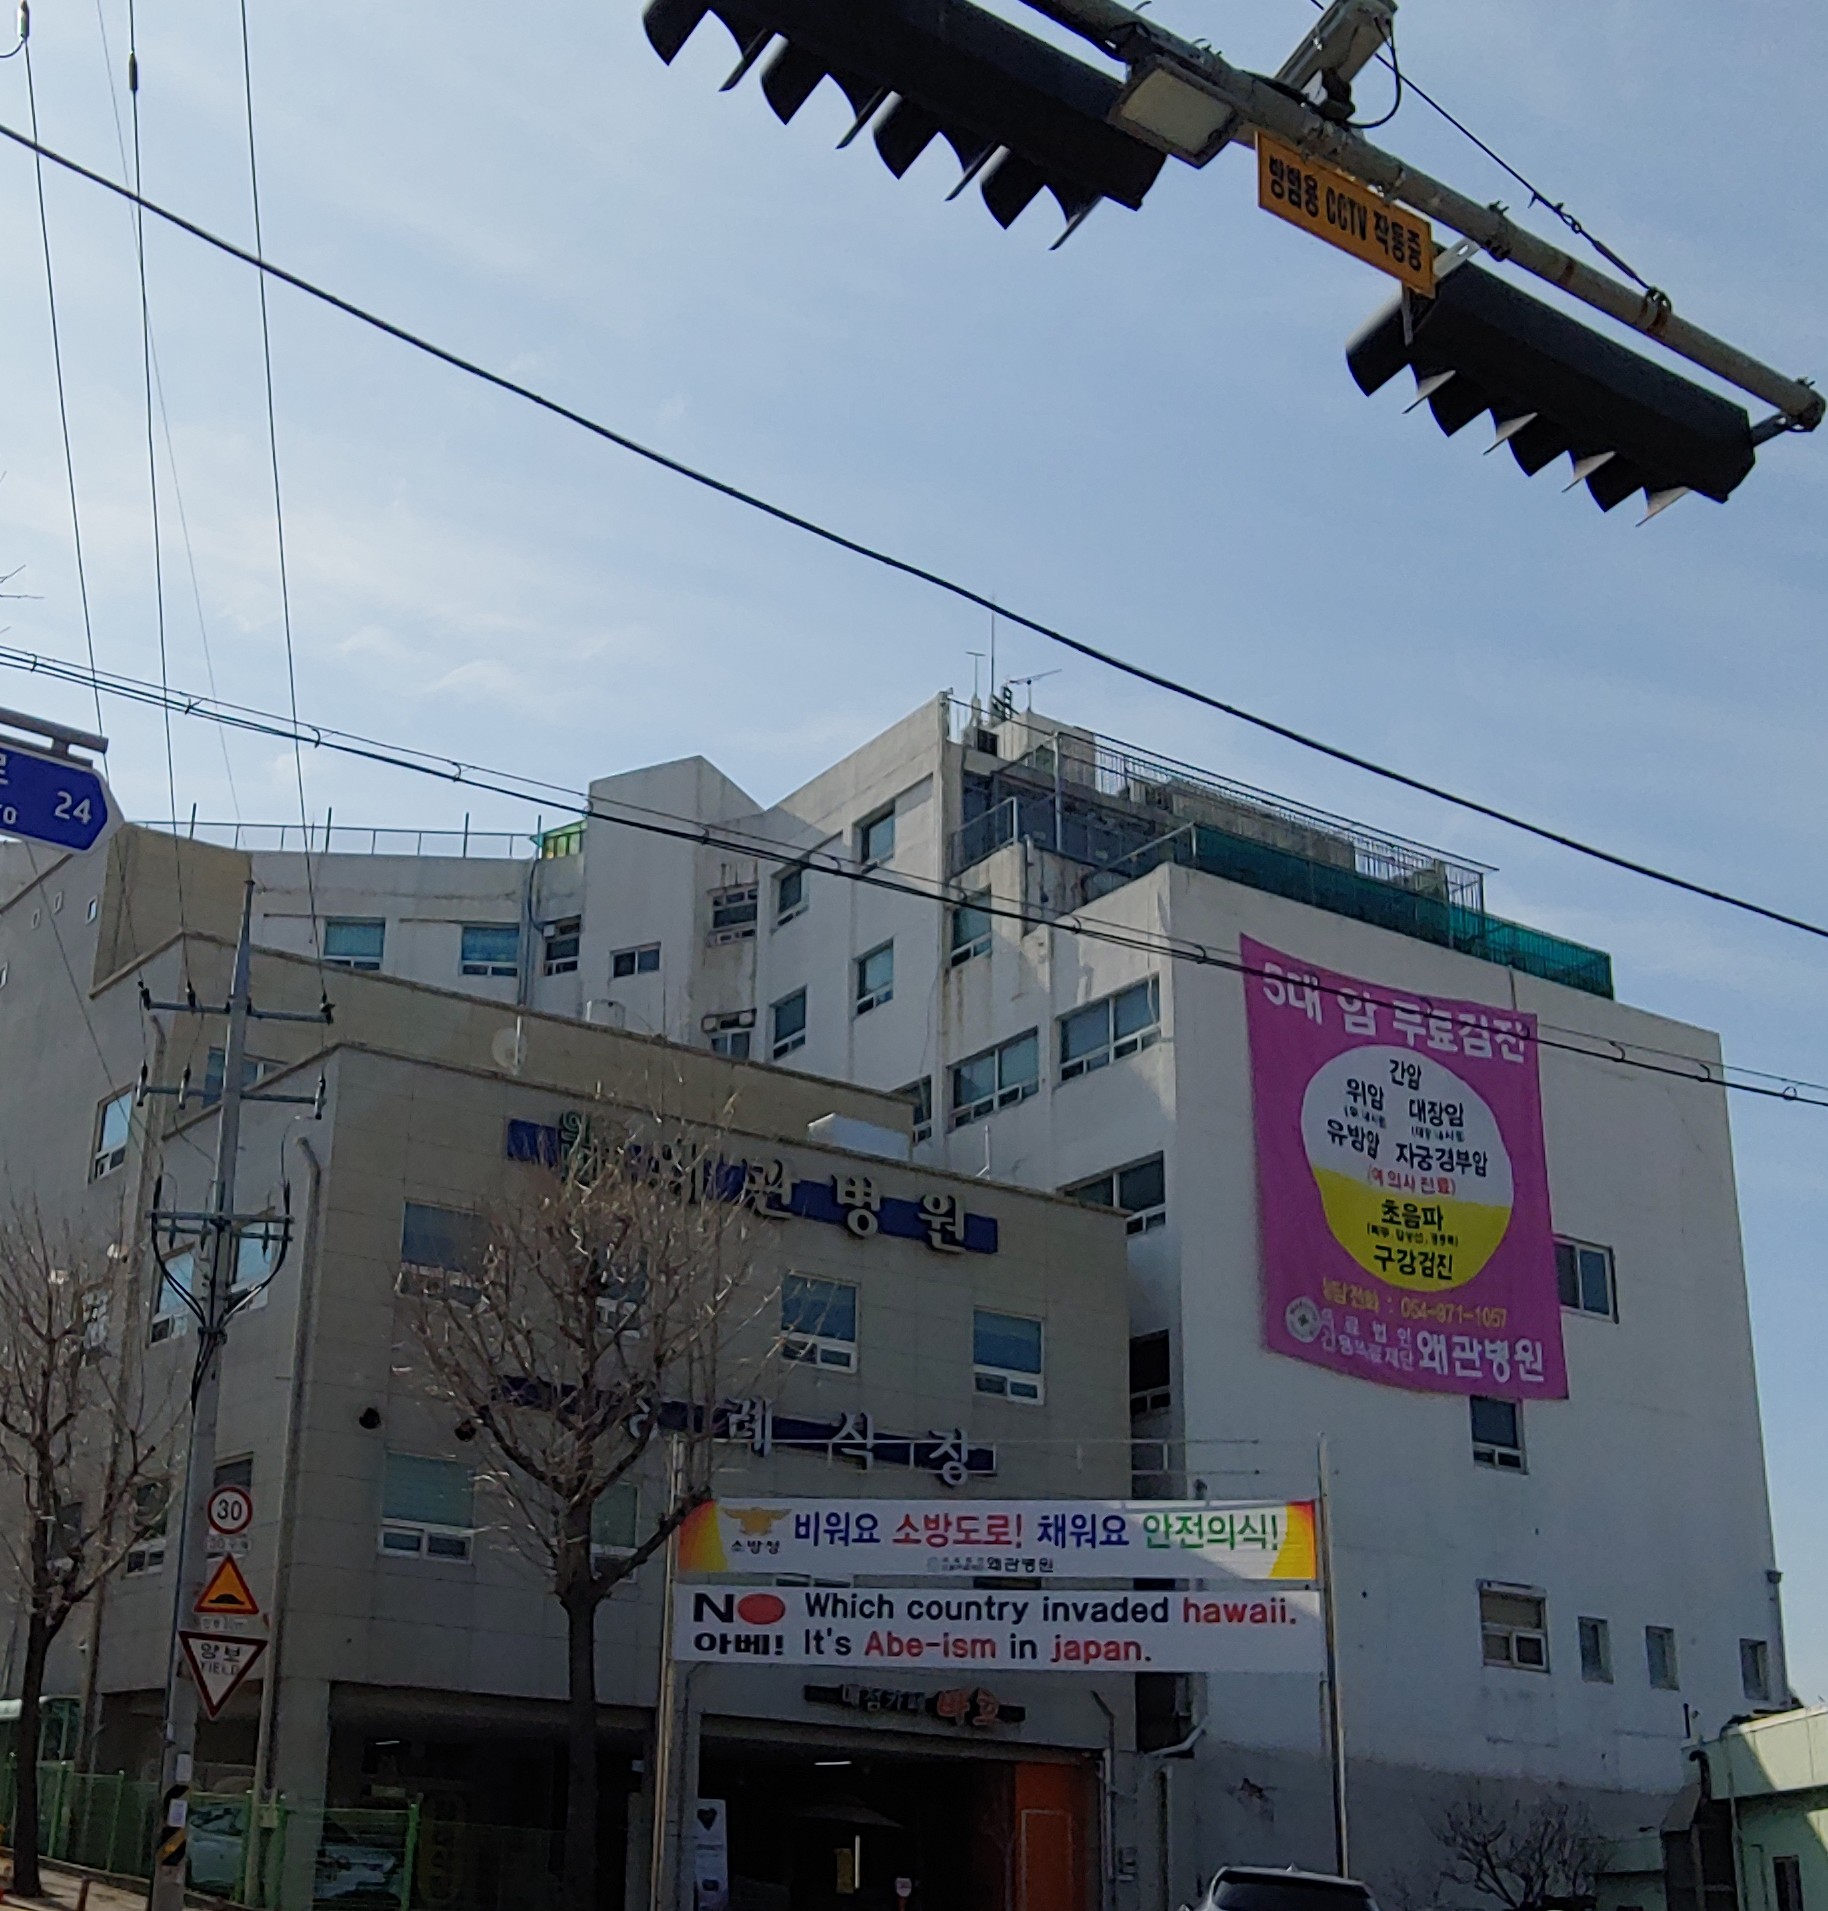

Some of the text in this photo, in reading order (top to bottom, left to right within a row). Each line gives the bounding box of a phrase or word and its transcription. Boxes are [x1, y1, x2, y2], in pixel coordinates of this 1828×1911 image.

[1268, 154, 1422, 272] 방범용 CCTV 작동중
[54, 790, 92, 824] 24
[1262, 961, 1527, 1061] 5대 암 무료검진
[1389, 1058, 1422, 1091] 간암
[1345, 1078, 1385, 1111] 위암
[1408, 1098, 1464, 1128] 대장암
[1327, 1118, 1380, 1160] 유방암
[1395, 1142, 1488, 1178] 자궁경부암
[1381, 1198, 1444, 1231] 초음파
[1373, 1244, 1453, 1280] 구강검진
[1416, 1329, 1545, 1383] 왜관병원
[627, 1397, 968, 1487] 례식장
[216, 1499, 243, 1521] 30
[731, 1539, 781, 1555] 소방청
[794, 1511, 1279, 1551] 비워요 소방도로! 채워요 안전의식!
[804, 1592, 1297, 1625] Which country invaded hawaii.
[201, 1643, 241, 1663] 양보
[694, 1631, 784, 1656] 아베!
[804, 1627, 1152, 1665] It's Abe-ism in japan.
